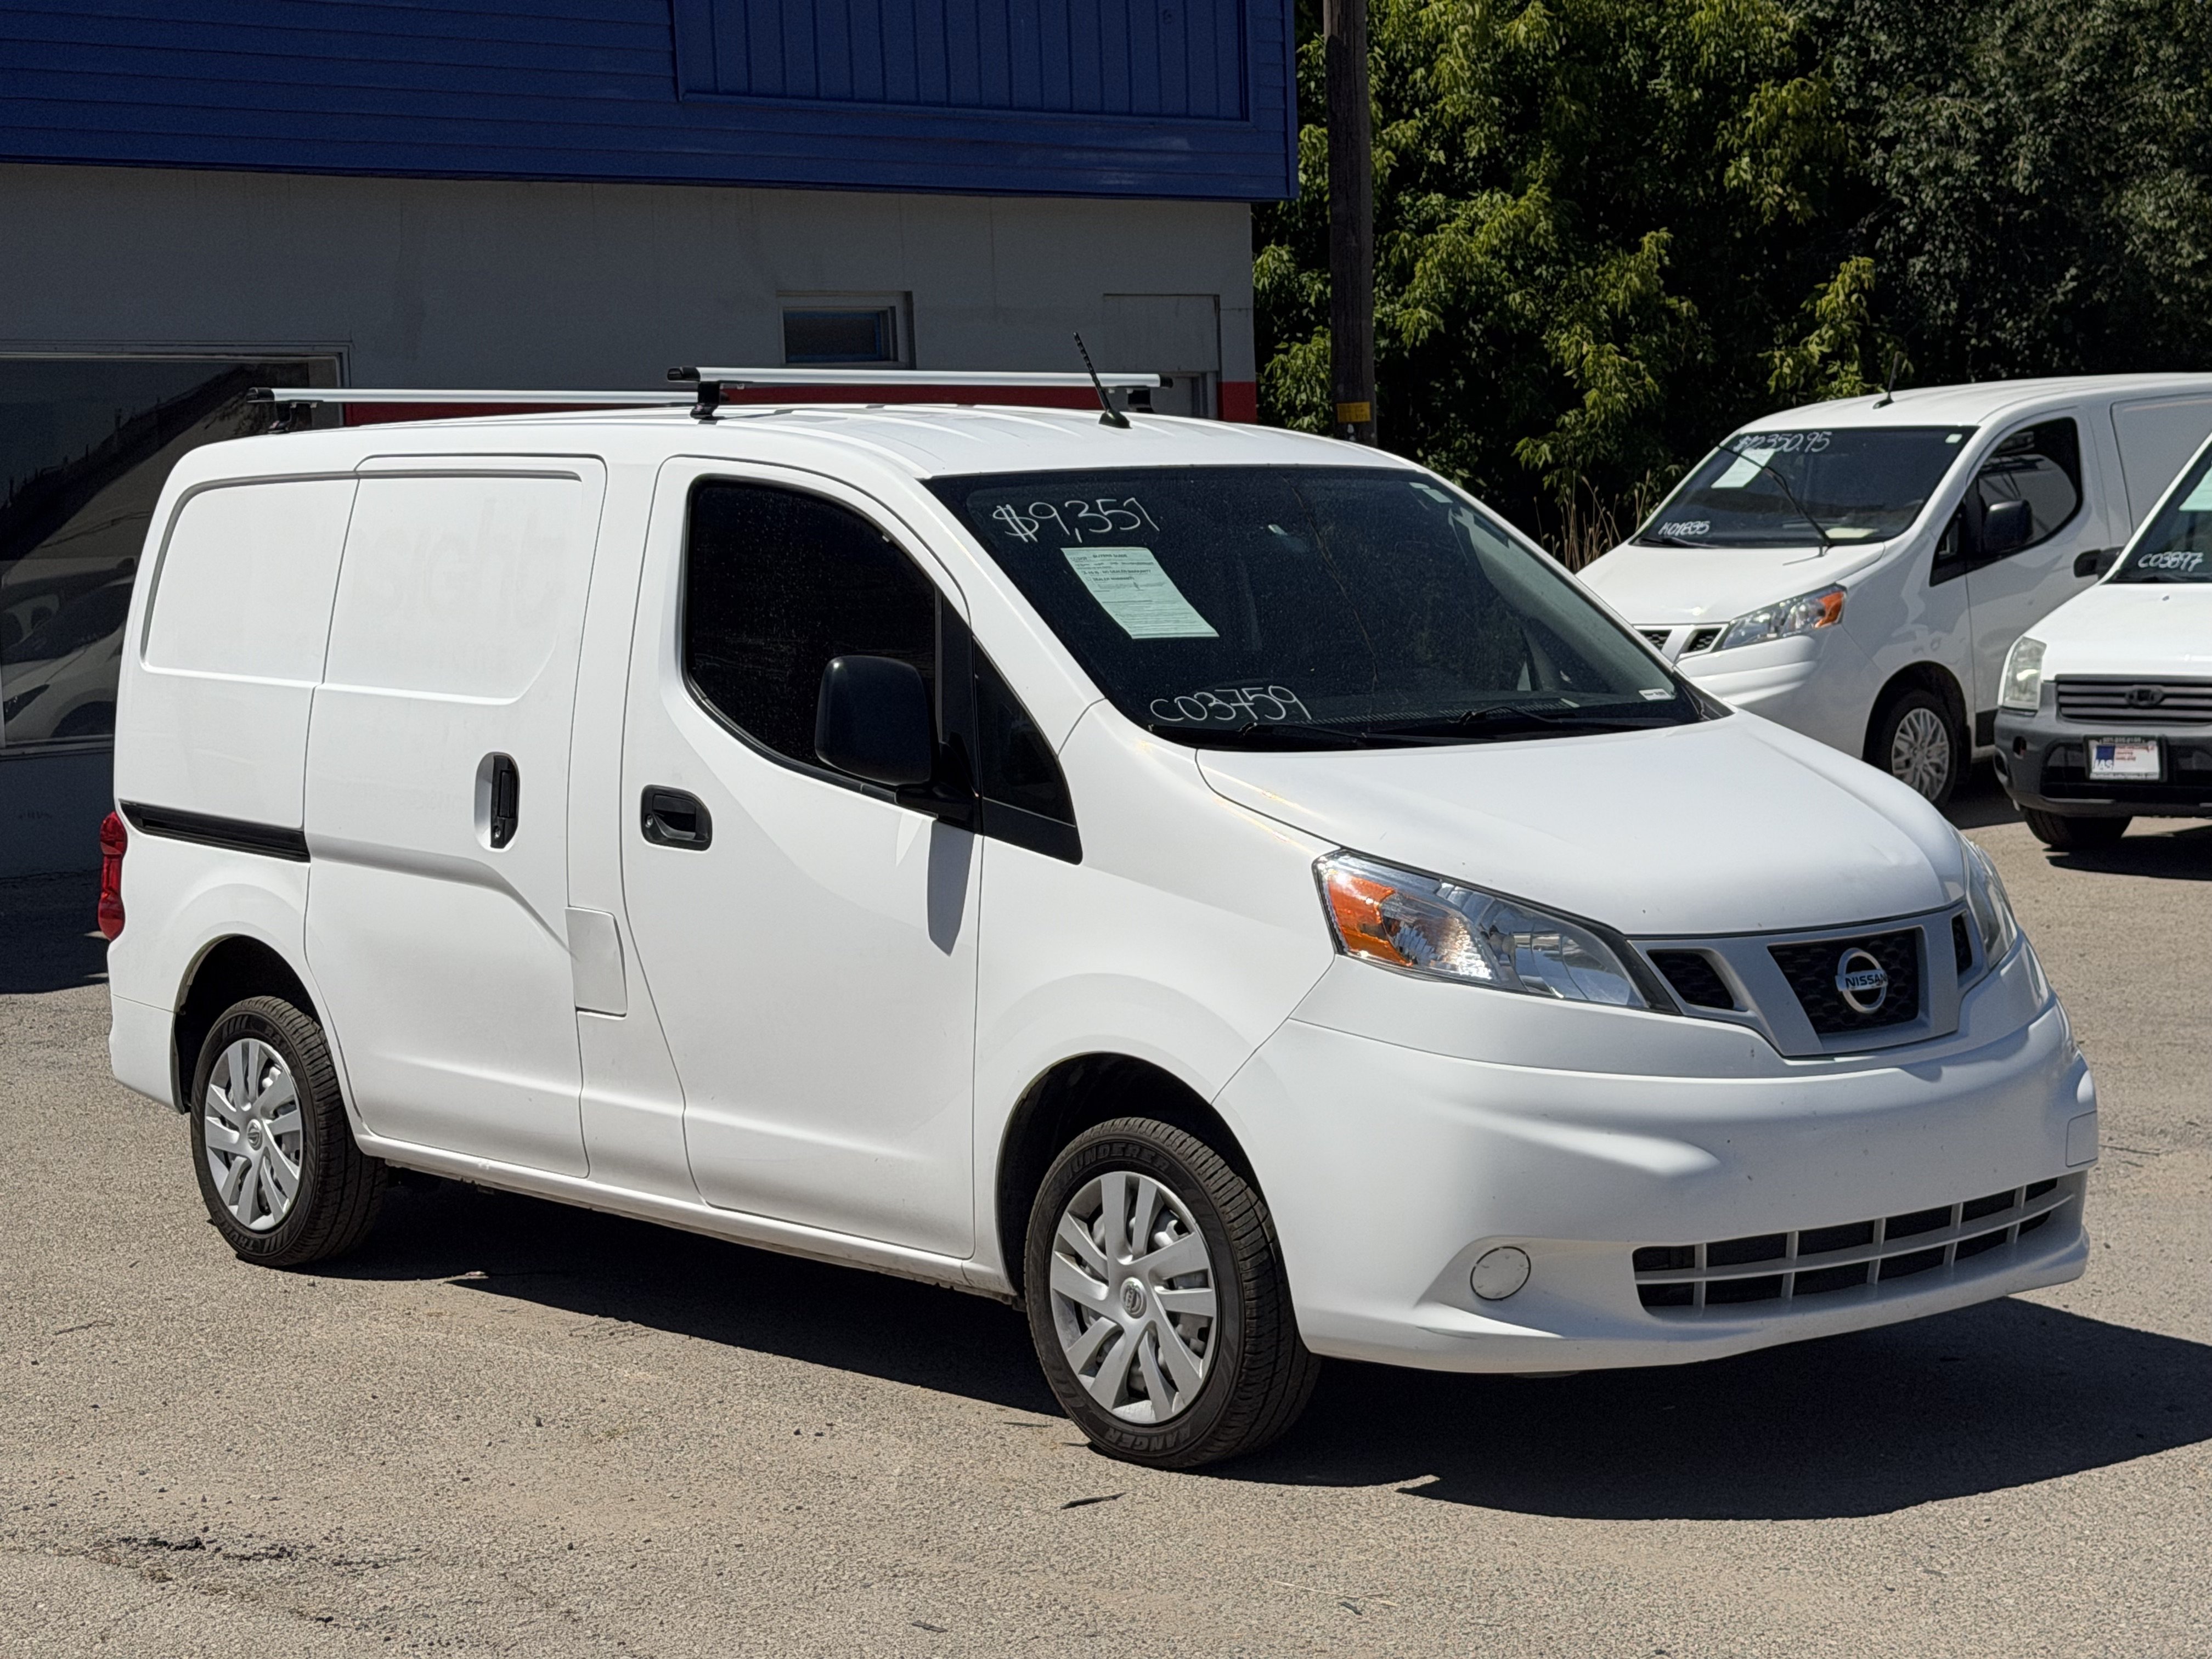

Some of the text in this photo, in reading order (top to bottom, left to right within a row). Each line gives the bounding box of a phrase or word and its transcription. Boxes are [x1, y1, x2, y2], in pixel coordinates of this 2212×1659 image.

[992, 497, 1160, 543] $9,351
[1150, 685, 1312, 722] C03759
[1845, 973, 1887, 988] NISSAN
[1104, 1423, 1191, 1452] RANGER
